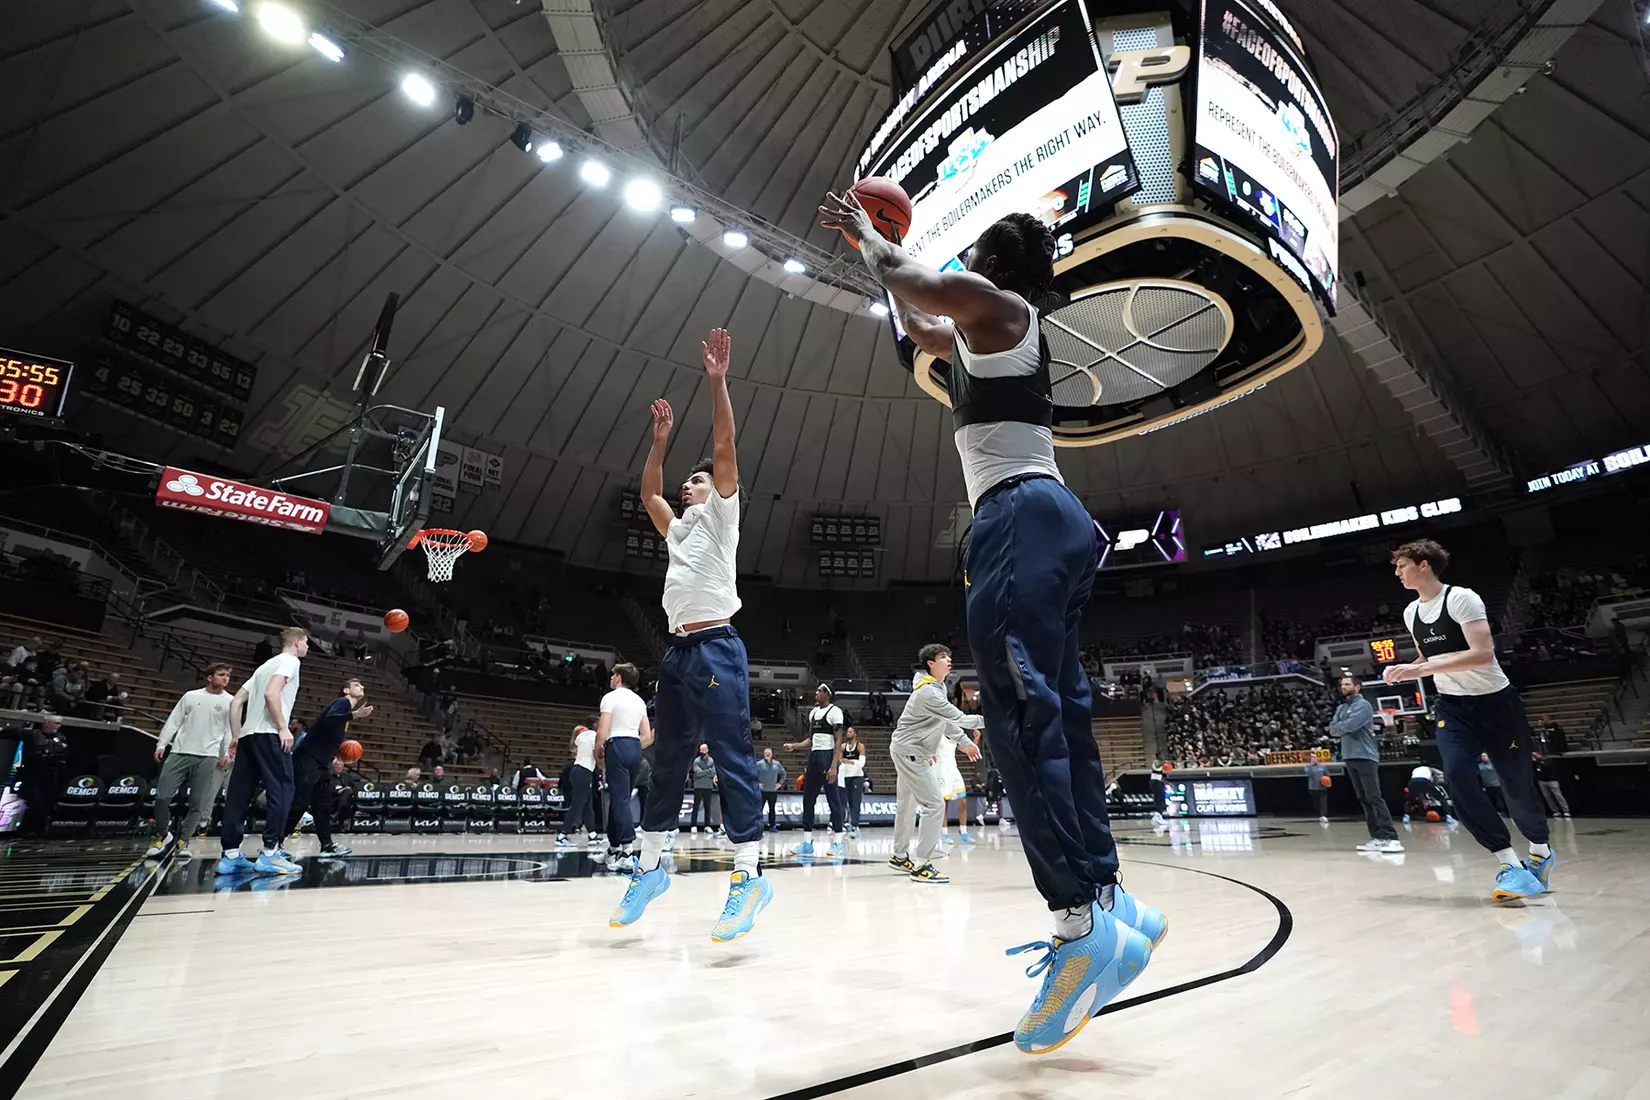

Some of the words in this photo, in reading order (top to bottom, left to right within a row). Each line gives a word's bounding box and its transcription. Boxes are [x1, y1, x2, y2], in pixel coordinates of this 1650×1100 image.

[884, 26, 1060, 184] FACEOFSPORTSMANSHIP
[1208, 101, 1256, 147] REPRESENT
[926, 226, 942, 244] THE
[941, 167, 1012, 232] BOILERMAKERS
[1013, 153, 1036, 177] THE
[1036, 129, 1071, 161] RIGHT
[1074, 110, 1106, 139] WAY.
[112, 314, 131, 332] 10
[137, 326, 161, 346] 22
[163, 338, 185, 358] 23
[187, 350, 208, 369] 33
[95, 367, 110, 382] 4
[211, 361, 231, 380] 55
[117, 376, 142, 396] 25
[145, 388, 169, 407] 33
[0, 404, 45, 417] TRONICS
[172, 399, 193, 417] 50
[201, 412, 213, 426] 3
[218, 418, 239, 437] 23
[1527, 476, 1551, 493] JOIN
[1550, 466, 1584, 485] TODAY
[1586, 461, 1600, 475] AT
[1283, 514, 1379, 544] BOILERMAKER
[1420, 498, 1462, 518] CLUB
[1370, 639, 1395, 650] 55:55
[1423, 634, 1448, 644] CATAPULT
[1376, 647, 1396, 662] 30
[1264, 751, 1302, 765] DEFENSE
[67, 786, 98, 795] GEMCO
[108, 786, 139, 795] GEMCO
[358, 791, 380, 799] GEMCO
[389, 790, 412, 799] GEMCO
[418, 791, 439, 799] GEMCO
[1194, 787, 1245, 800] MACKEY
[1196, 804, 1214, 813] OUR
